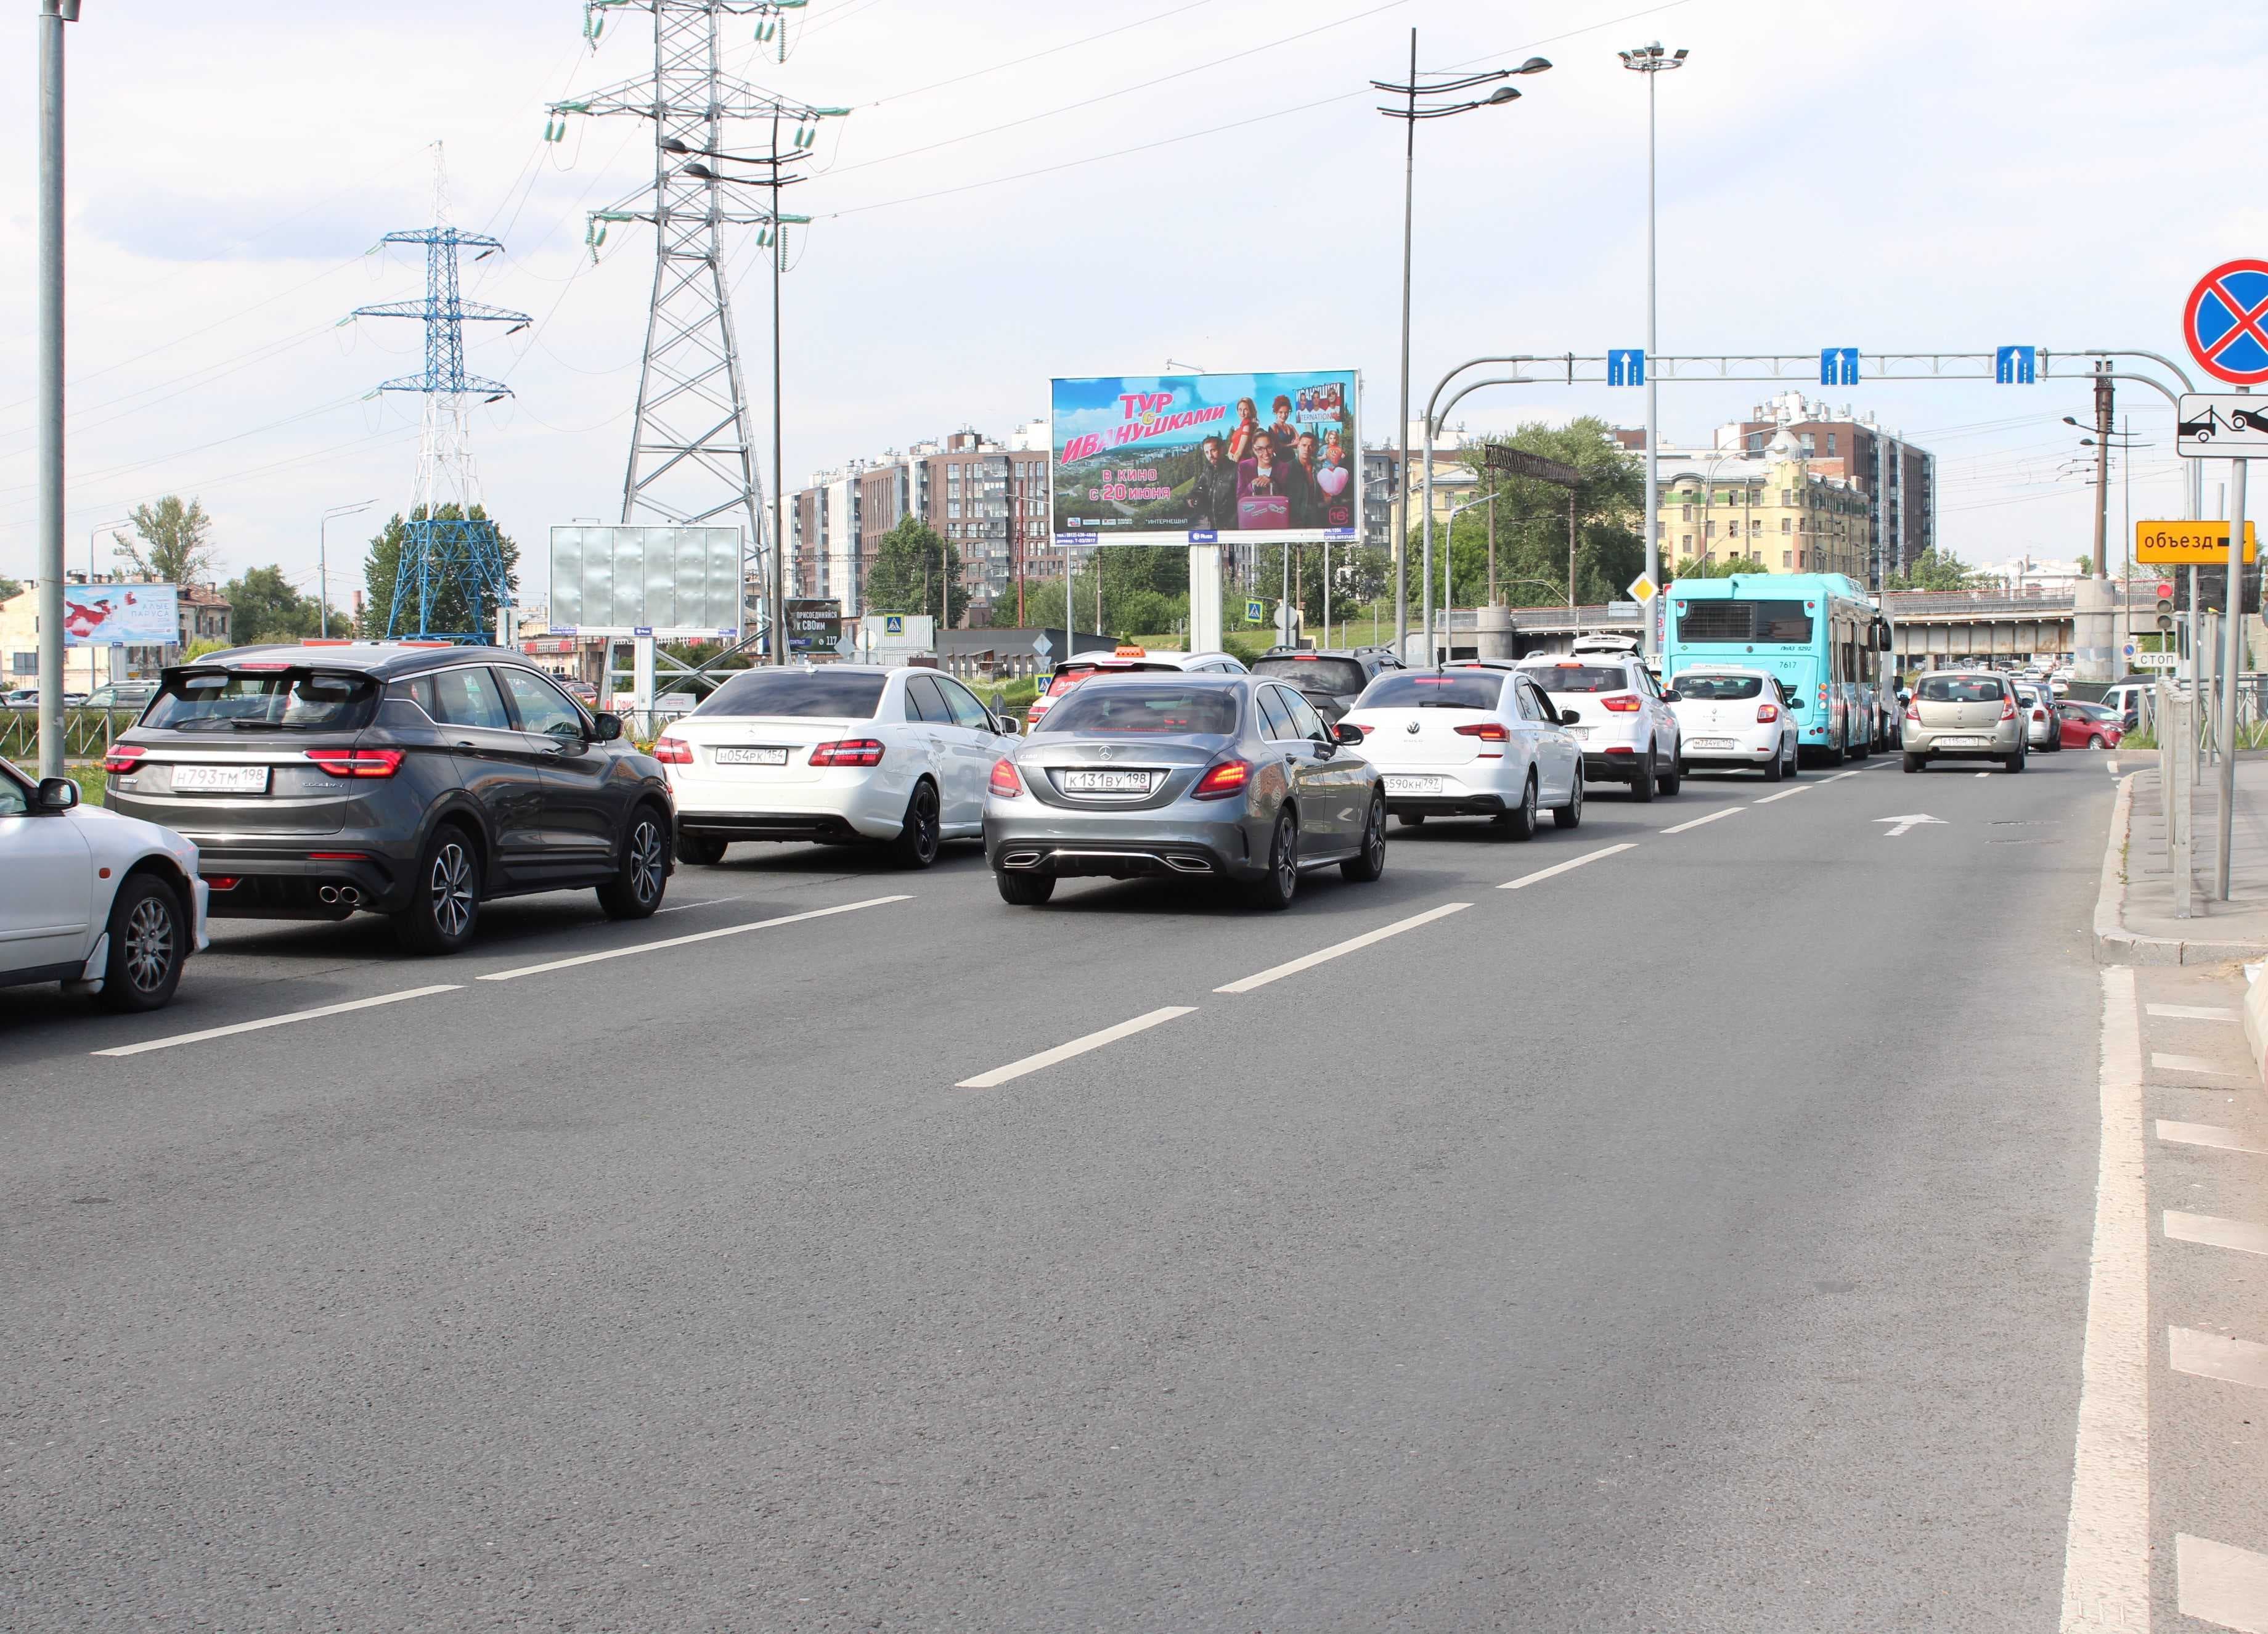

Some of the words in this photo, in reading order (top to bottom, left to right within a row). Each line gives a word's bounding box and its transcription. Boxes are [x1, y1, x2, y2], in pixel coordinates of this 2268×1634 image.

[1120, 393, 1173, 420] ТУР
[1060, 405, 1226, 466] ИВАНУШКАМИ
[1103, 470, 1112, 482] В
[1117, 469, 1157, 481] КИНО
[1103, 484, 1126, 500] 20
[1128, 487, 1170, 500] ИЮНЯ
[2145, 532, 2213, 550] объезд
[796, 610, 838, 619] ПРИСОЕДИНЯЙСЯ
[826, 635, 837, 645] 117
[2140, 655, 2174, 664] СТОП
[767, 750, 783, 759] 154
[242, 769, 263, 780] 198
[1126, 773, 1146, 784] 198
